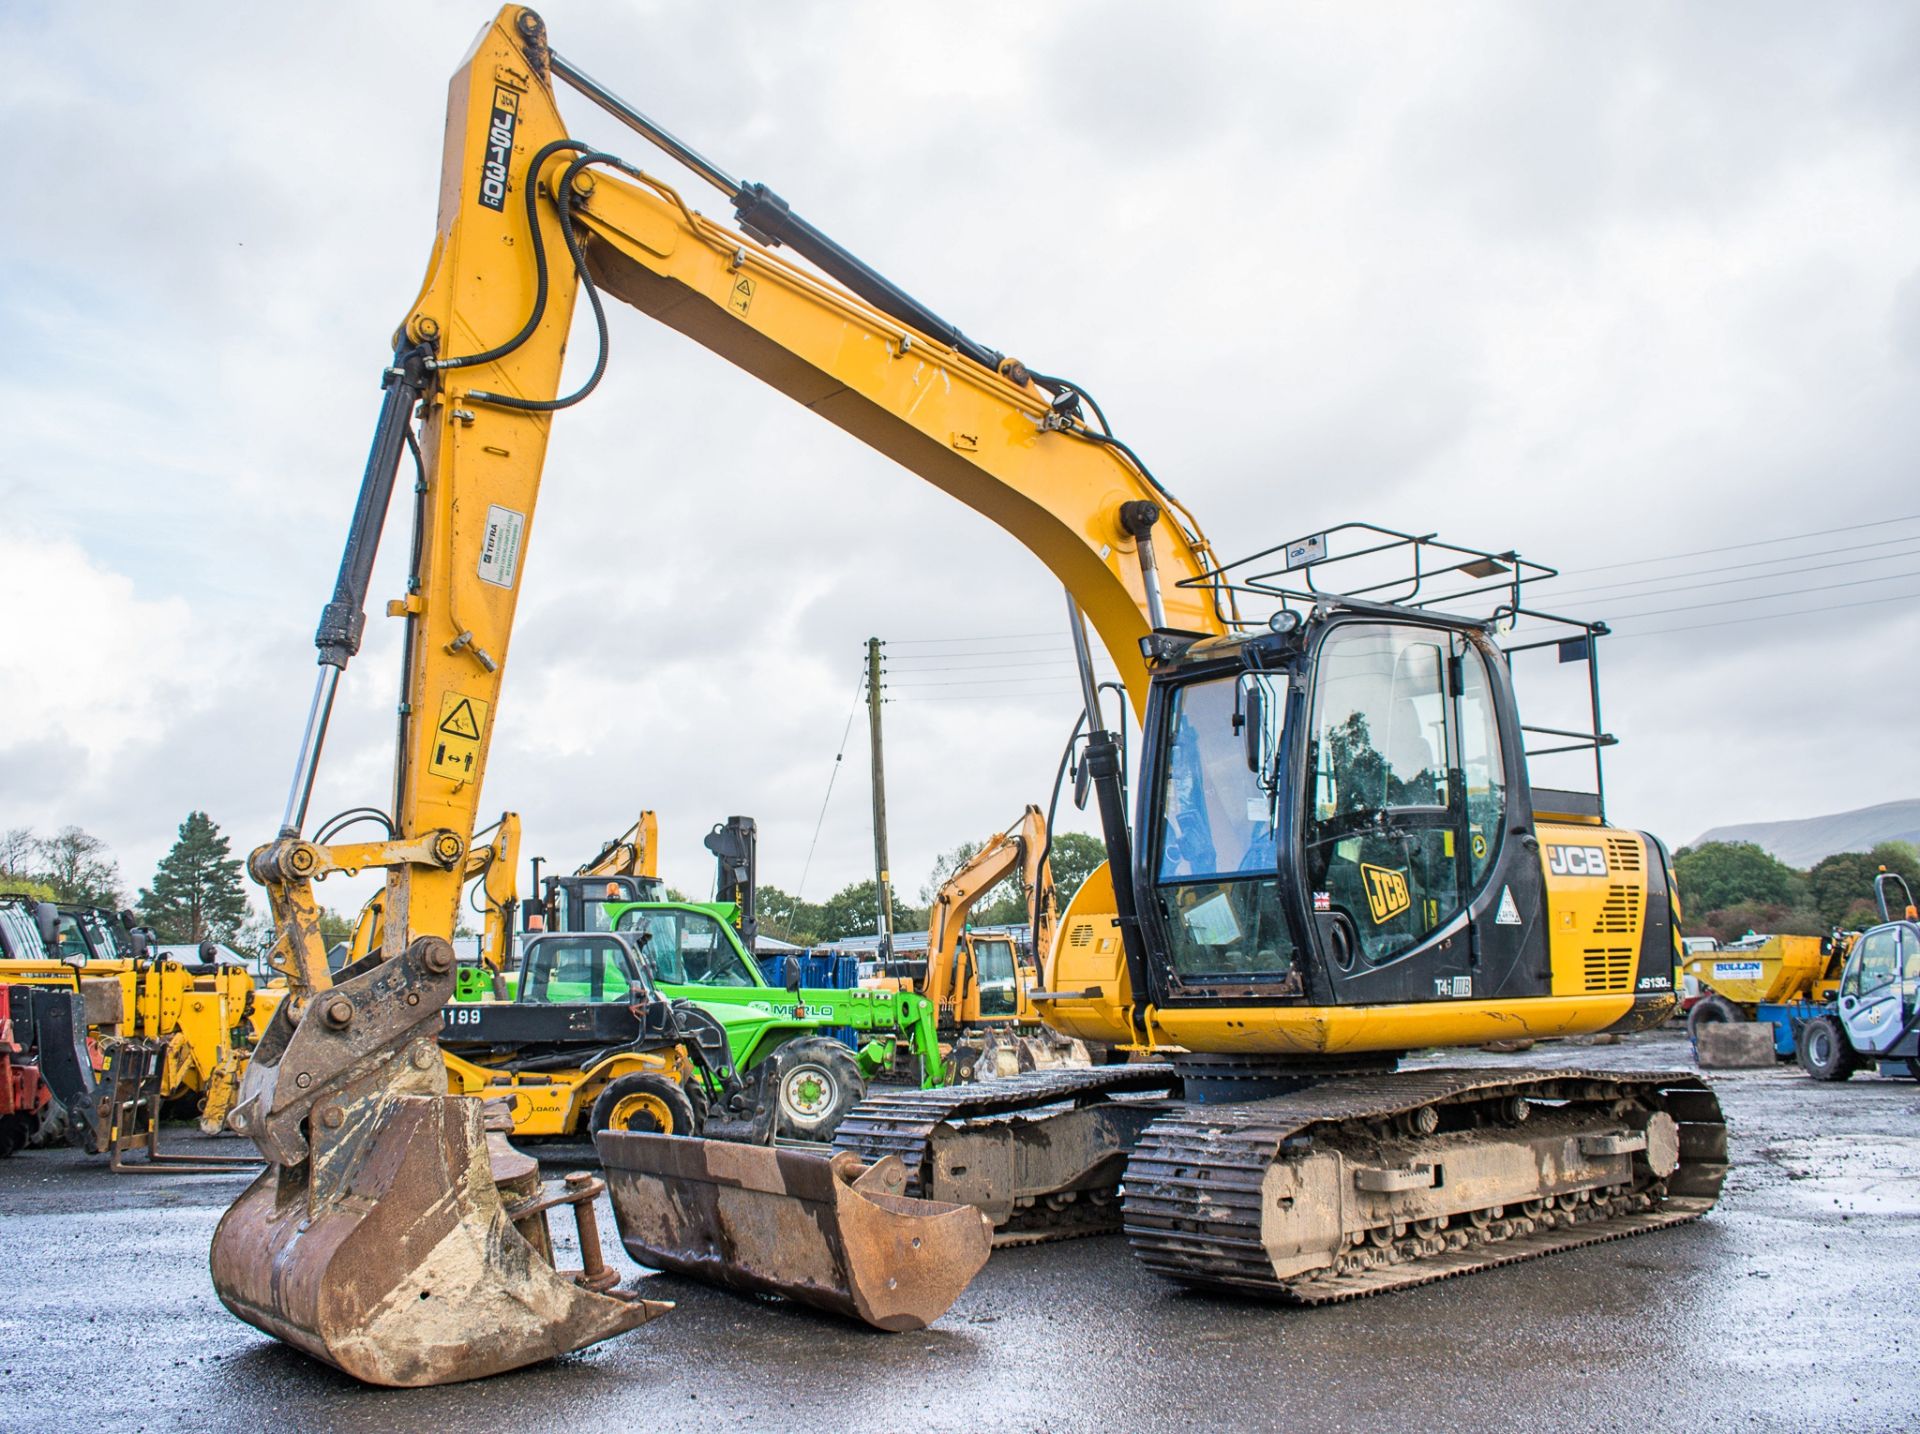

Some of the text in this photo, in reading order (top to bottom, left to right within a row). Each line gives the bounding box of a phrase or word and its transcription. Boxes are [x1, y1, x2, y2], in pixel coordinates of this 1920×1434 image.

[482, 114, 513, 206] JS130 LC
[1548, 846, 1607, 875] JCB
[1369, 869, 1407, 918] JCB
[1716, 962, 1760, 971] BULLEN
[1638, 977, 1667, 989] JS130
